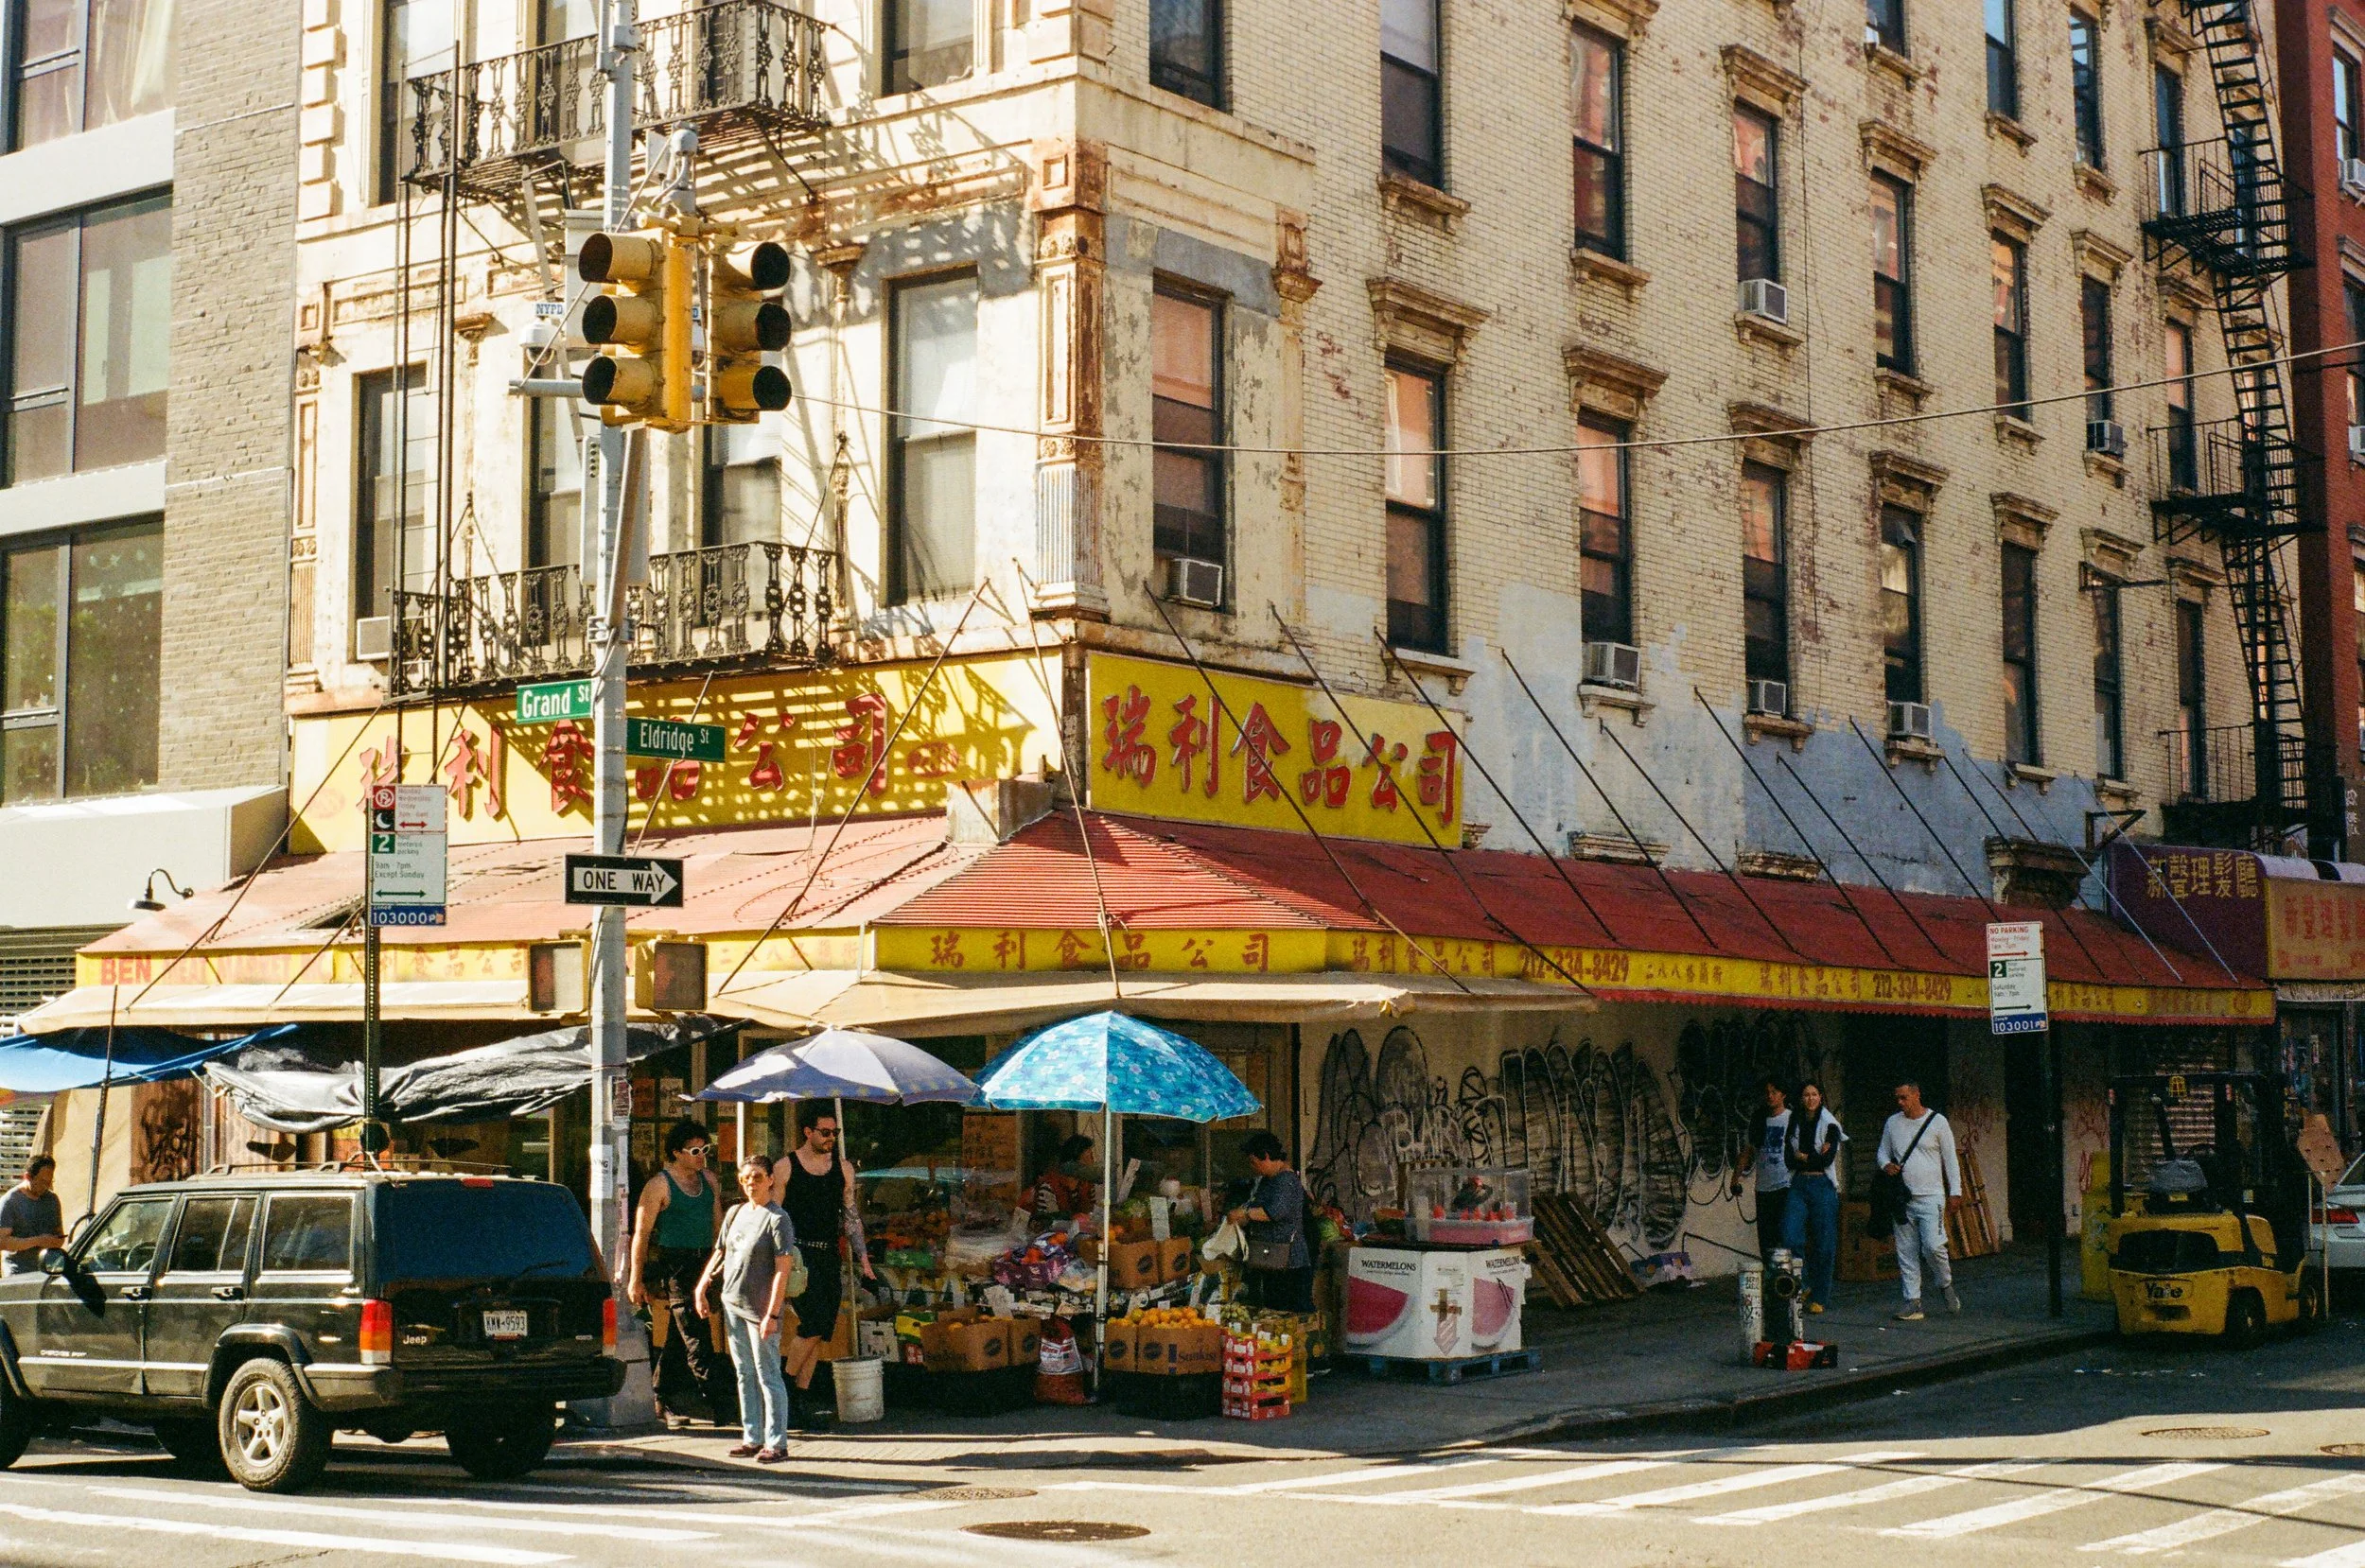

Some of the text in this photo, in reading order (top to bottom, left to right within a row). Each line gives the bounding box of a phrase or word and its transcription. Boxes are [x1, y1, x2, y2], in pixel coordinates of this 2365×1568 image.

[536, 304, 563, 314] NYPD
[522, 685, 590, 719] Grand St
[640, 723, 710, 758] Eldridge St
[1102, 683, 1457, 828] 瑞利食品公司
[378, 834, 390, 852] 2
[375, 871, 425, 880] Except Sunday
[584, 871, 666, 893] ONE WAY
[2001, 926, 2029, 934] PARKING
[931, 930, 1270, 971] 瑞利食品公司
[101, 955, 151, 985] BEN
[1517, 949, 1630, 982] 212-334-8429
[1994, 963, 2003, 977] 2
[1872, 972, 1952, 1002] 212-334-8429
[1361, 1260, 1416, 1272] WATERMELONS
[1485, 1256, 1520, 1268] WATERMELONS
[403, 1334, 428, 1346] Jeep
